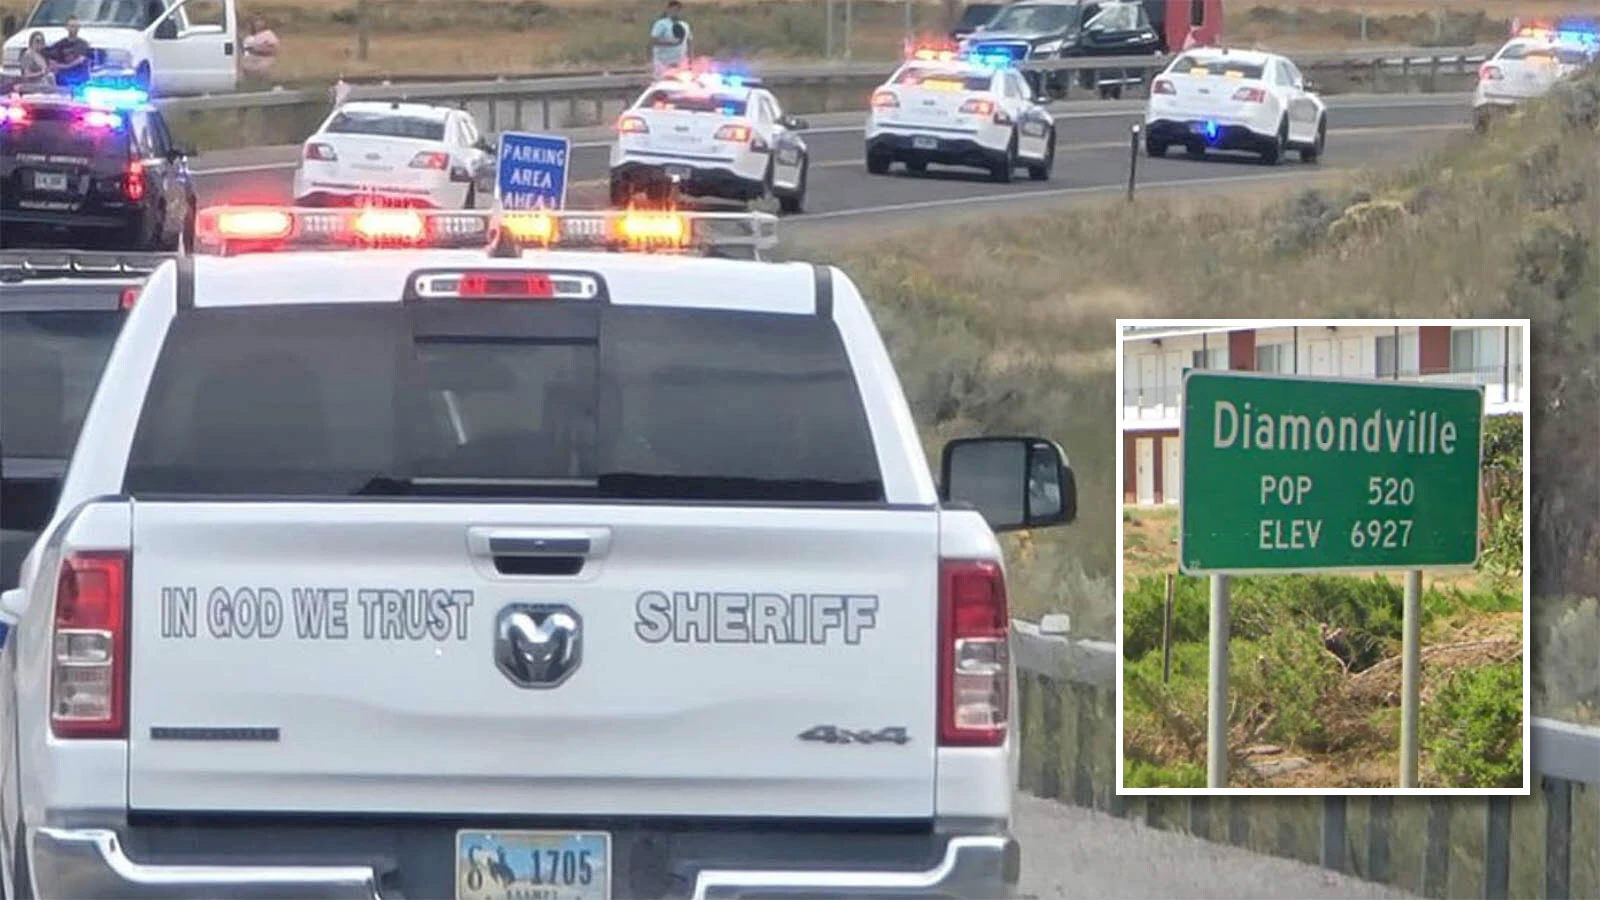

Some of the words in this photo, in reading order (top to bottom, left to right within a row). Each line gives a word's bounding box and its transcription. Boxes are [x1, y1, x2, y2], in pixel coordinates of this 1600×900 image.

[502, 143, 565, 167] PARKING
[510, 167, 553, 188] AREA
[1213, 400, 1458, 454] Diamondville
[1260, 475, 1312, 505] POP
[1368, 476, 1415, 505] 520
[1259, 519, 1323, 549] ELEV
[1350, 520, 1414, 548] 6927
[161, 587, 197, 638] IN
[207, 587, 283, 639] GOD
[292, 588, 348, 640] WE
[358, 589, 474, 642] TRUST
[635, 590, 879, 645] SHERIFF
[531, 849, 592, 886] 1705
